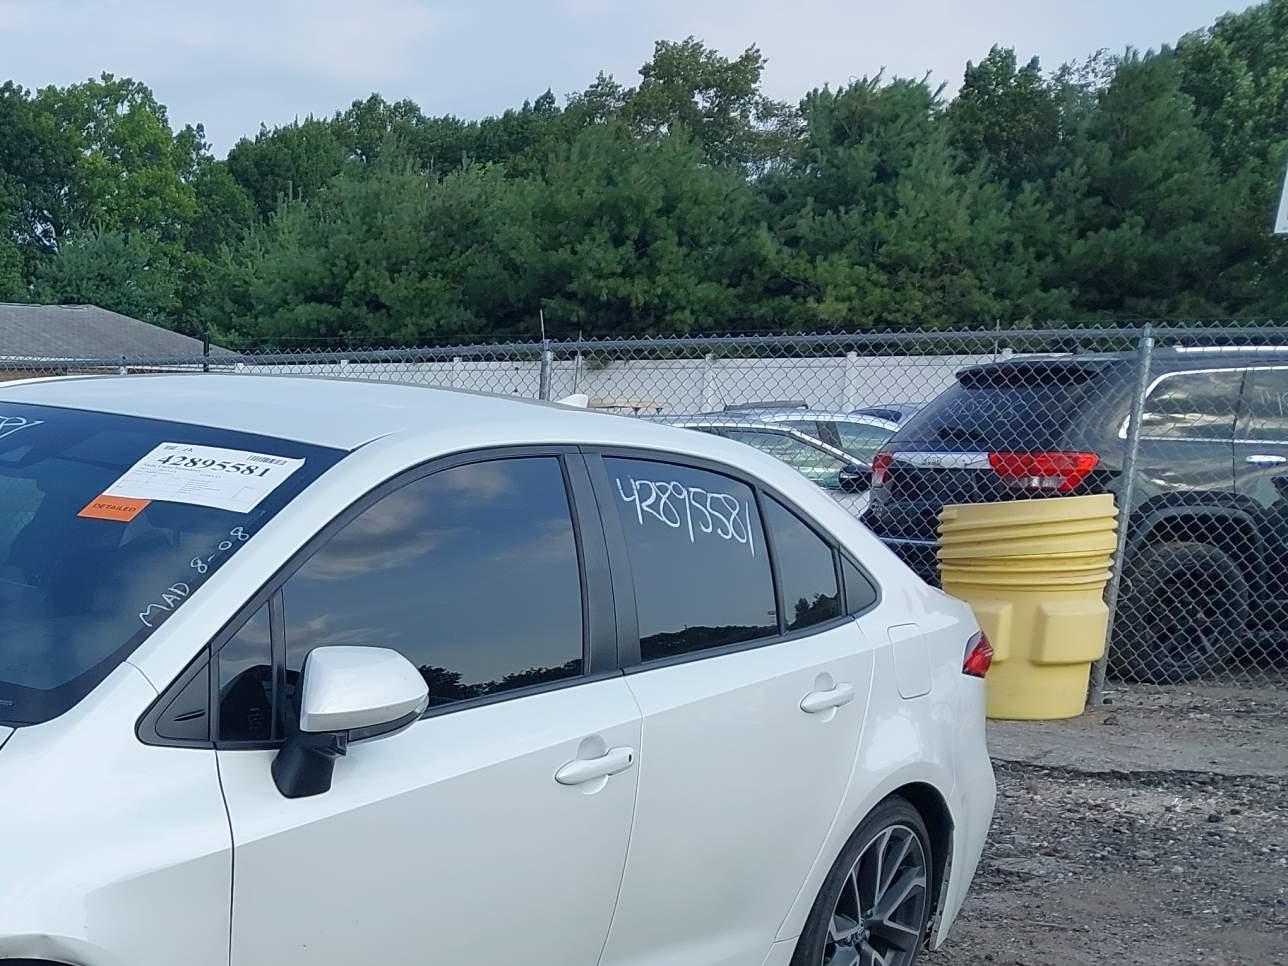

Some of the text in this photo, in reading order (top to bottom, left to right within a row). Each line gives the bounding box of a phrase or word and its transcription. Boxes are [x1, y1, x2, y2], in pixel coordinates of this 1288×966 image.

[157, 453, 272, 478] 42895581
[92, 502, 137, 513] DETAILED
[615, 475, 755, 559] 42895581
[138, 526, 250, 628] MAD 8-08
